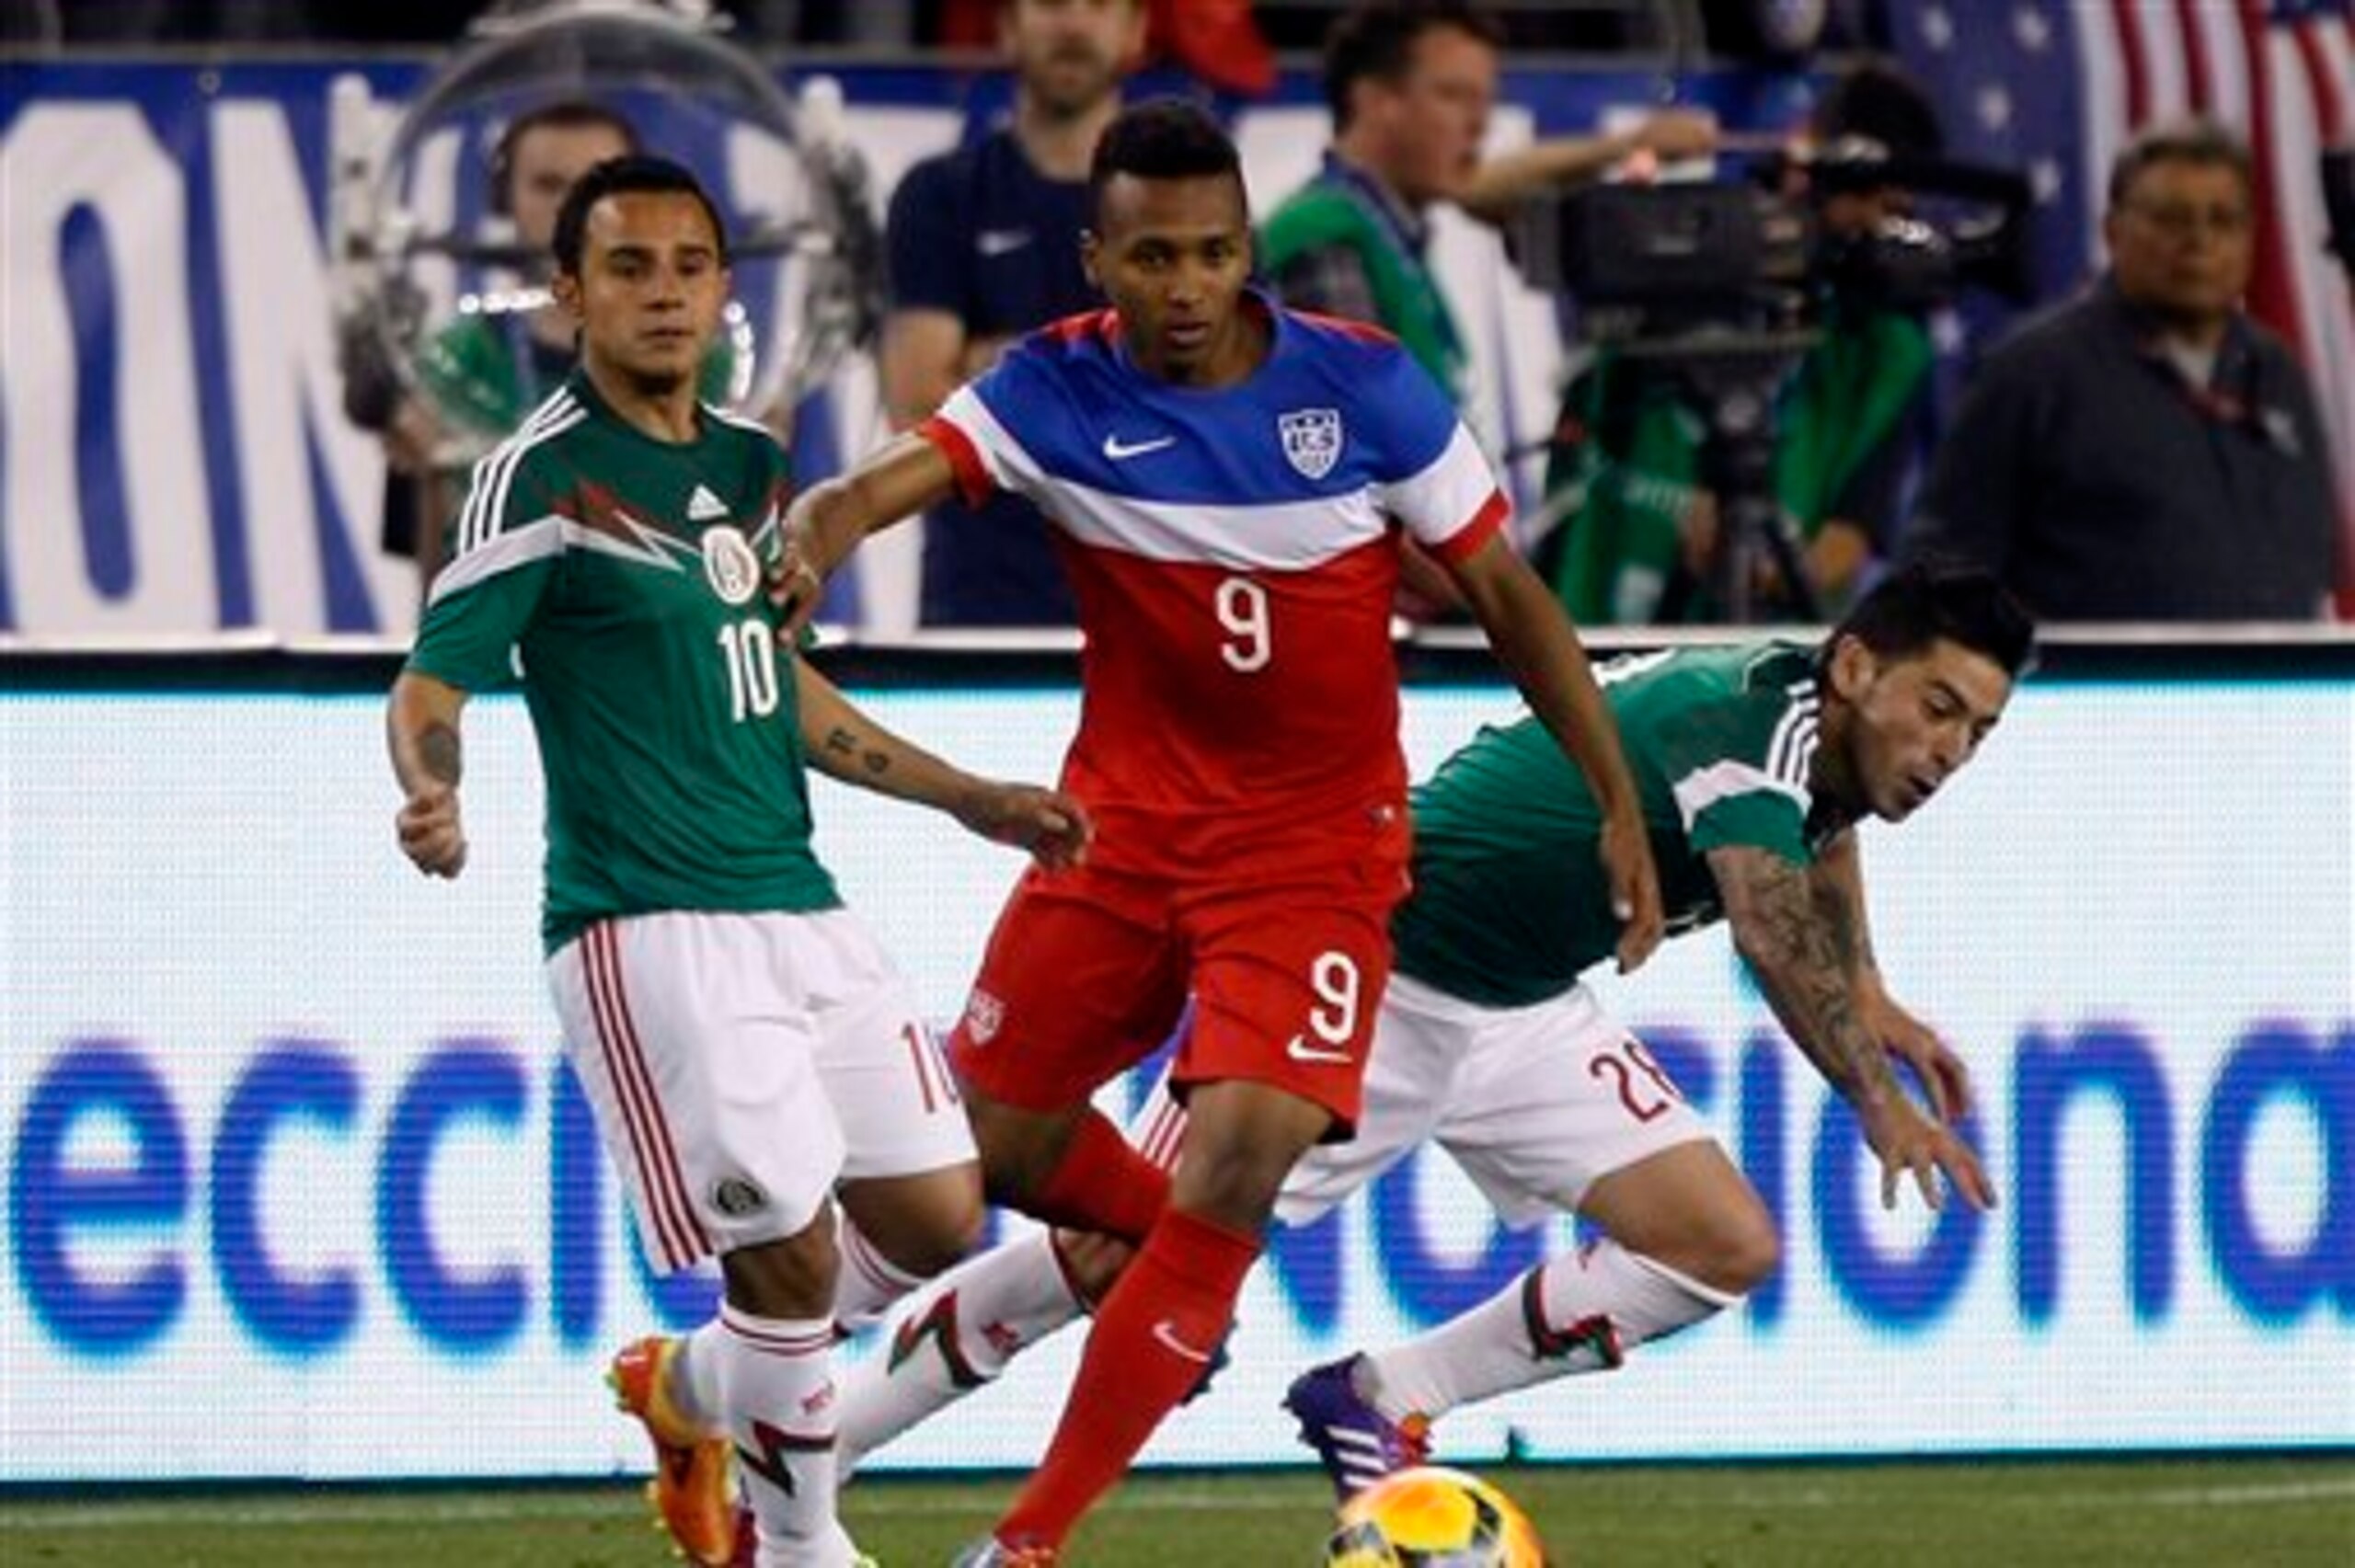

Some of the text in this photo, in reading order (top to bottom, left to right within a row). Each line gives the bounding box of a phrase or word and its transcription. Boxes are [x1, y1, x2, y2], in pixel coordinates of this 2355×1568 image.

[717, 618, 778, 723] 10
[1215, 577, 1271, 672] 9
[1310, 950, 1360, 1045] 9
